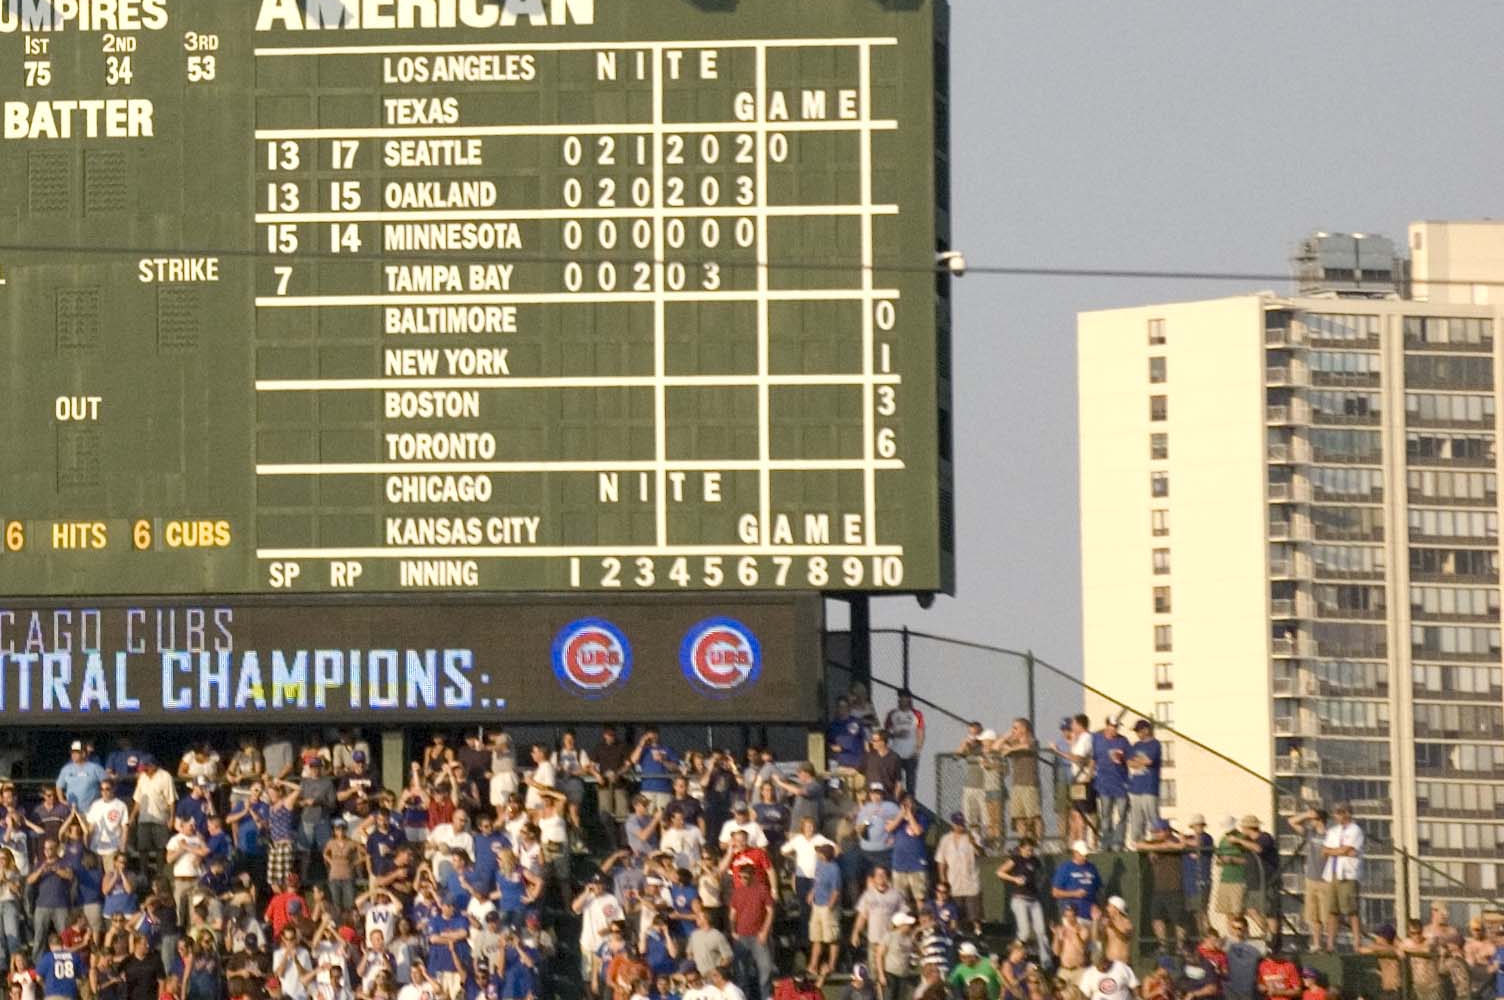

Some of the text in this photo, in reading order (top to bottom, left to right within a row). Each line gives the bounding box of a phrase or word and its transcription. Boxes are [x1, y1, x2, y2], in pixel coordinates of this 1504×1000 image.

[23, 60, 52, 87] 75
[106, 55, 133, 86] 34
[187, 54, 216, 82] 53
[383, 54, 536, 84] LOS ANGELES
[4, 98, 154, 139] BATTER
[383, 96, 459, 125] TEXAS
[268, 132, 788, 171] 13 17 SEATTLE 0 2 1 2 0 2 0
[267, 175, 754, 212] 13 15 OAKLAND 0 2 0 2 0 3
[267, 222, 522, 254] 15 14 MINNESOTA
[138, 257, 219, 283] STRIKE
[274, 263, 514, 296] 7 TAMPA BAY
[385, 300, 896, 334] BALTIMORE 0
[385, 343, 890, 376] NEW YORK 1
[55, 396, 102, 421] OUT
[385, 385, 896, 419] BOSTON 3
[385, 427, 897, 461] TORONTO 6
[385, 474, 492, 503] CHICAGO
[6, 521, 24, 551] 6
[52, 522, 107, 549] HITS
[133, 519, 151, 549] 6
[165, 520, 231, 548] CUBS
[386, 516, 540, 546] KANSAS CITY
[269, 555, 904, 588] SP RP INNING 1 2 3 4 5 6 7 8 9 10
[127, 608, 234, 653] CUBS
[54, 960, 74, 979] 08
